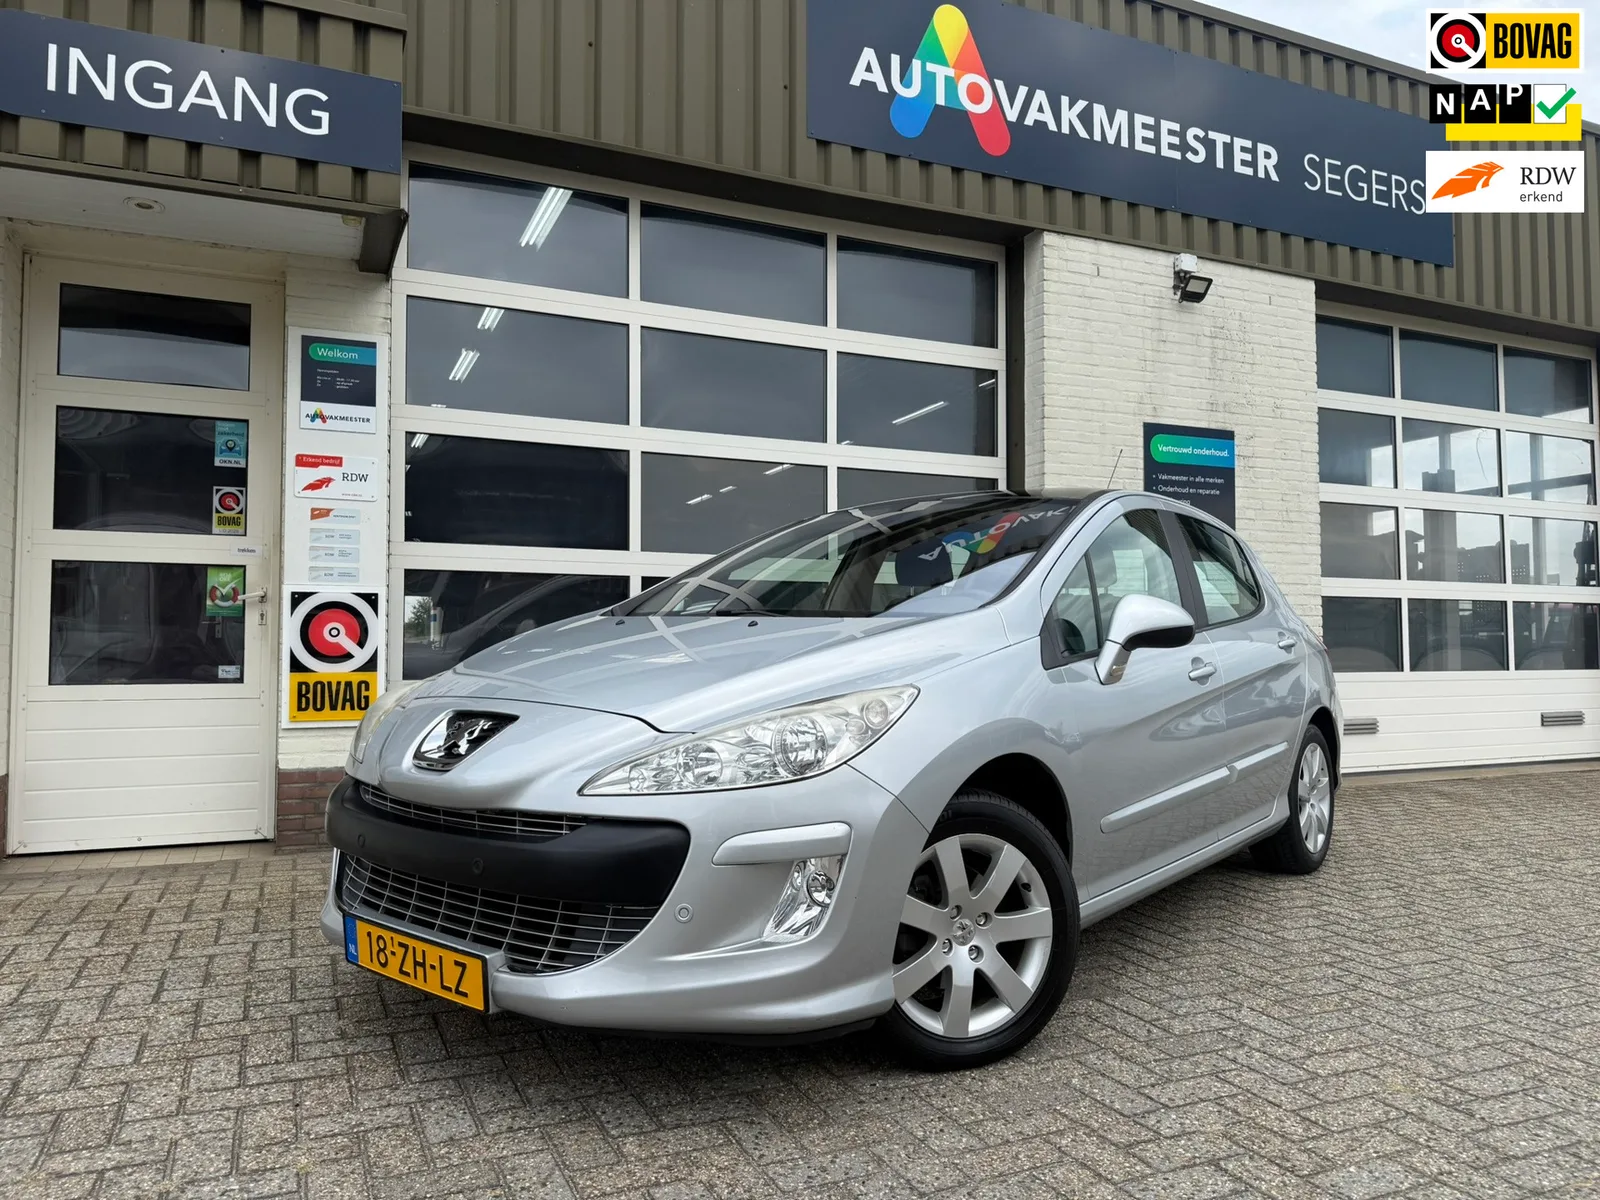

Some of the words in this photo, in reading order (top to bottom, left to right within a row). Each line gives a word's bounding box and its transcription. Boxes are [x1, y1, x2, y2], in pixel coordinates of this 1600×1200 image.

[46, 43, 330, 136] INGANG
[849, 46, 1280, 182] AUTOVAKMEESTER
[1303, 153, 1425, 215] SEGERS
[317, 347, 358, 360] Welkom
[305, 412, 371, 424] AUTOVAKMEESTER
[1157, 443, 1192, 454] Vertrouwd
[1193, 447, 1230, 457] onderhoud.
[218, 458, 242, 466] OKN.NL
[323, 457, 340, 465] bedrijf
[342, 472, 369, 482] RDW
[1157, 473, 1188, 482] Vakmeester
[1195, 475, 1204, 483] alle
[1205, 476, 1225, 484] merken
[1157, 485, 1189, 494] Onderhoud
[1197, 488, 1220, 496] reparatie
[217, 515, 241, 527] BOVAG
[297, 680, 370, 712] BOVAG
[348, 943, 357, 956] NL
